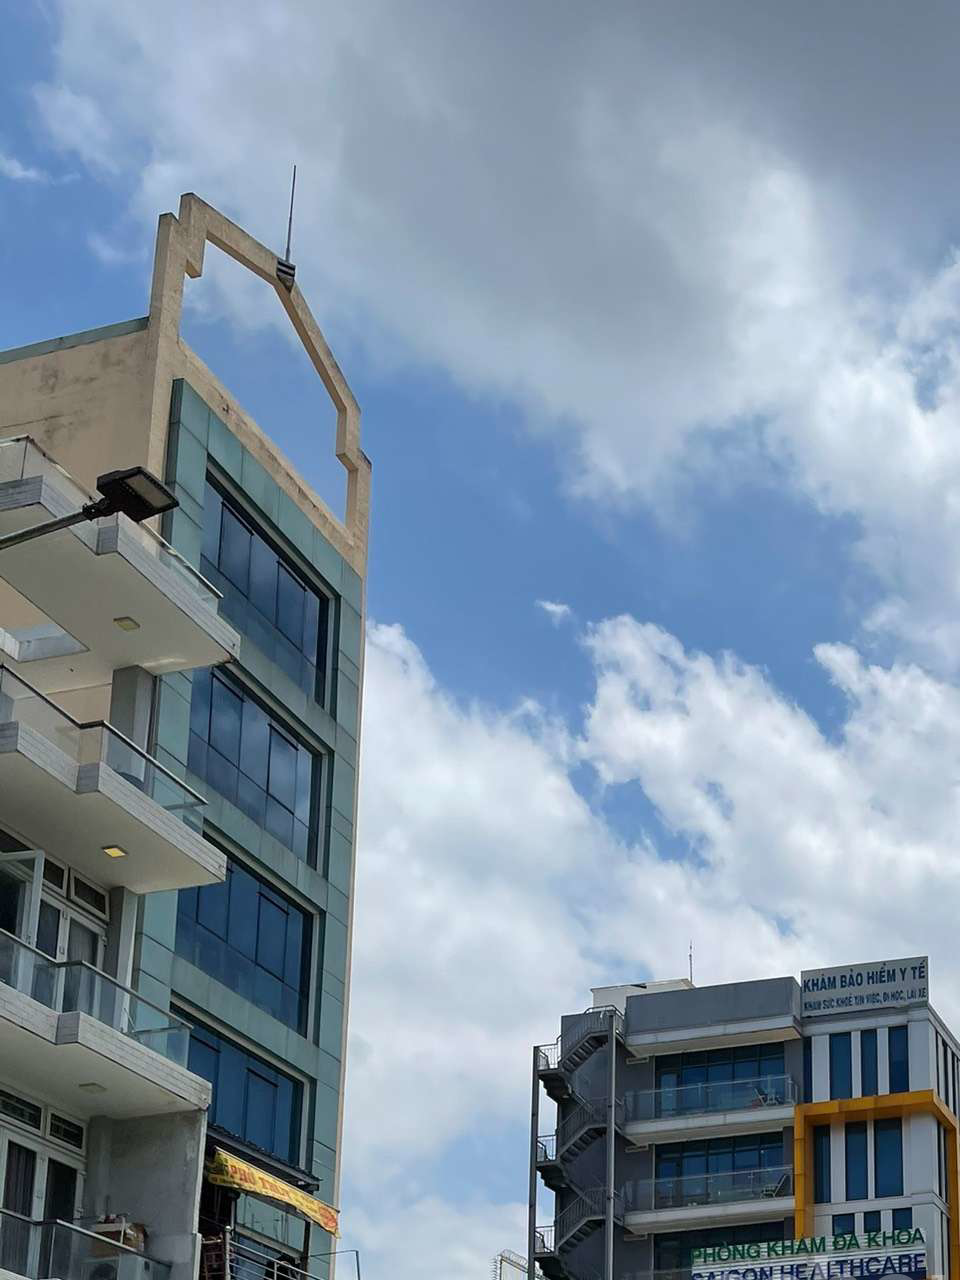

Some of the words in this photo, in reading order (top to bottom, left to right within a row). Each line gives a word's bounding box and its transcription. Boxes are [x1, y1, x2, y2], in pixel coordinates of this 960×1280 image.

[803, 974, 836, 992] KHÁM
[840, 968, 863, 989] BẢO
[867, 962, 896, 985] HIỂM
[899, 967, 907, 981] Y
[911, 959, 926, 980] TẾ
[690, 1240, 761, 1263] PHÒNG
[767, 1234, 826, 1258] KHÁM
[832, 1233, 860, 1251] ĐA
[867, 1228, 926, 1248] KHOA
